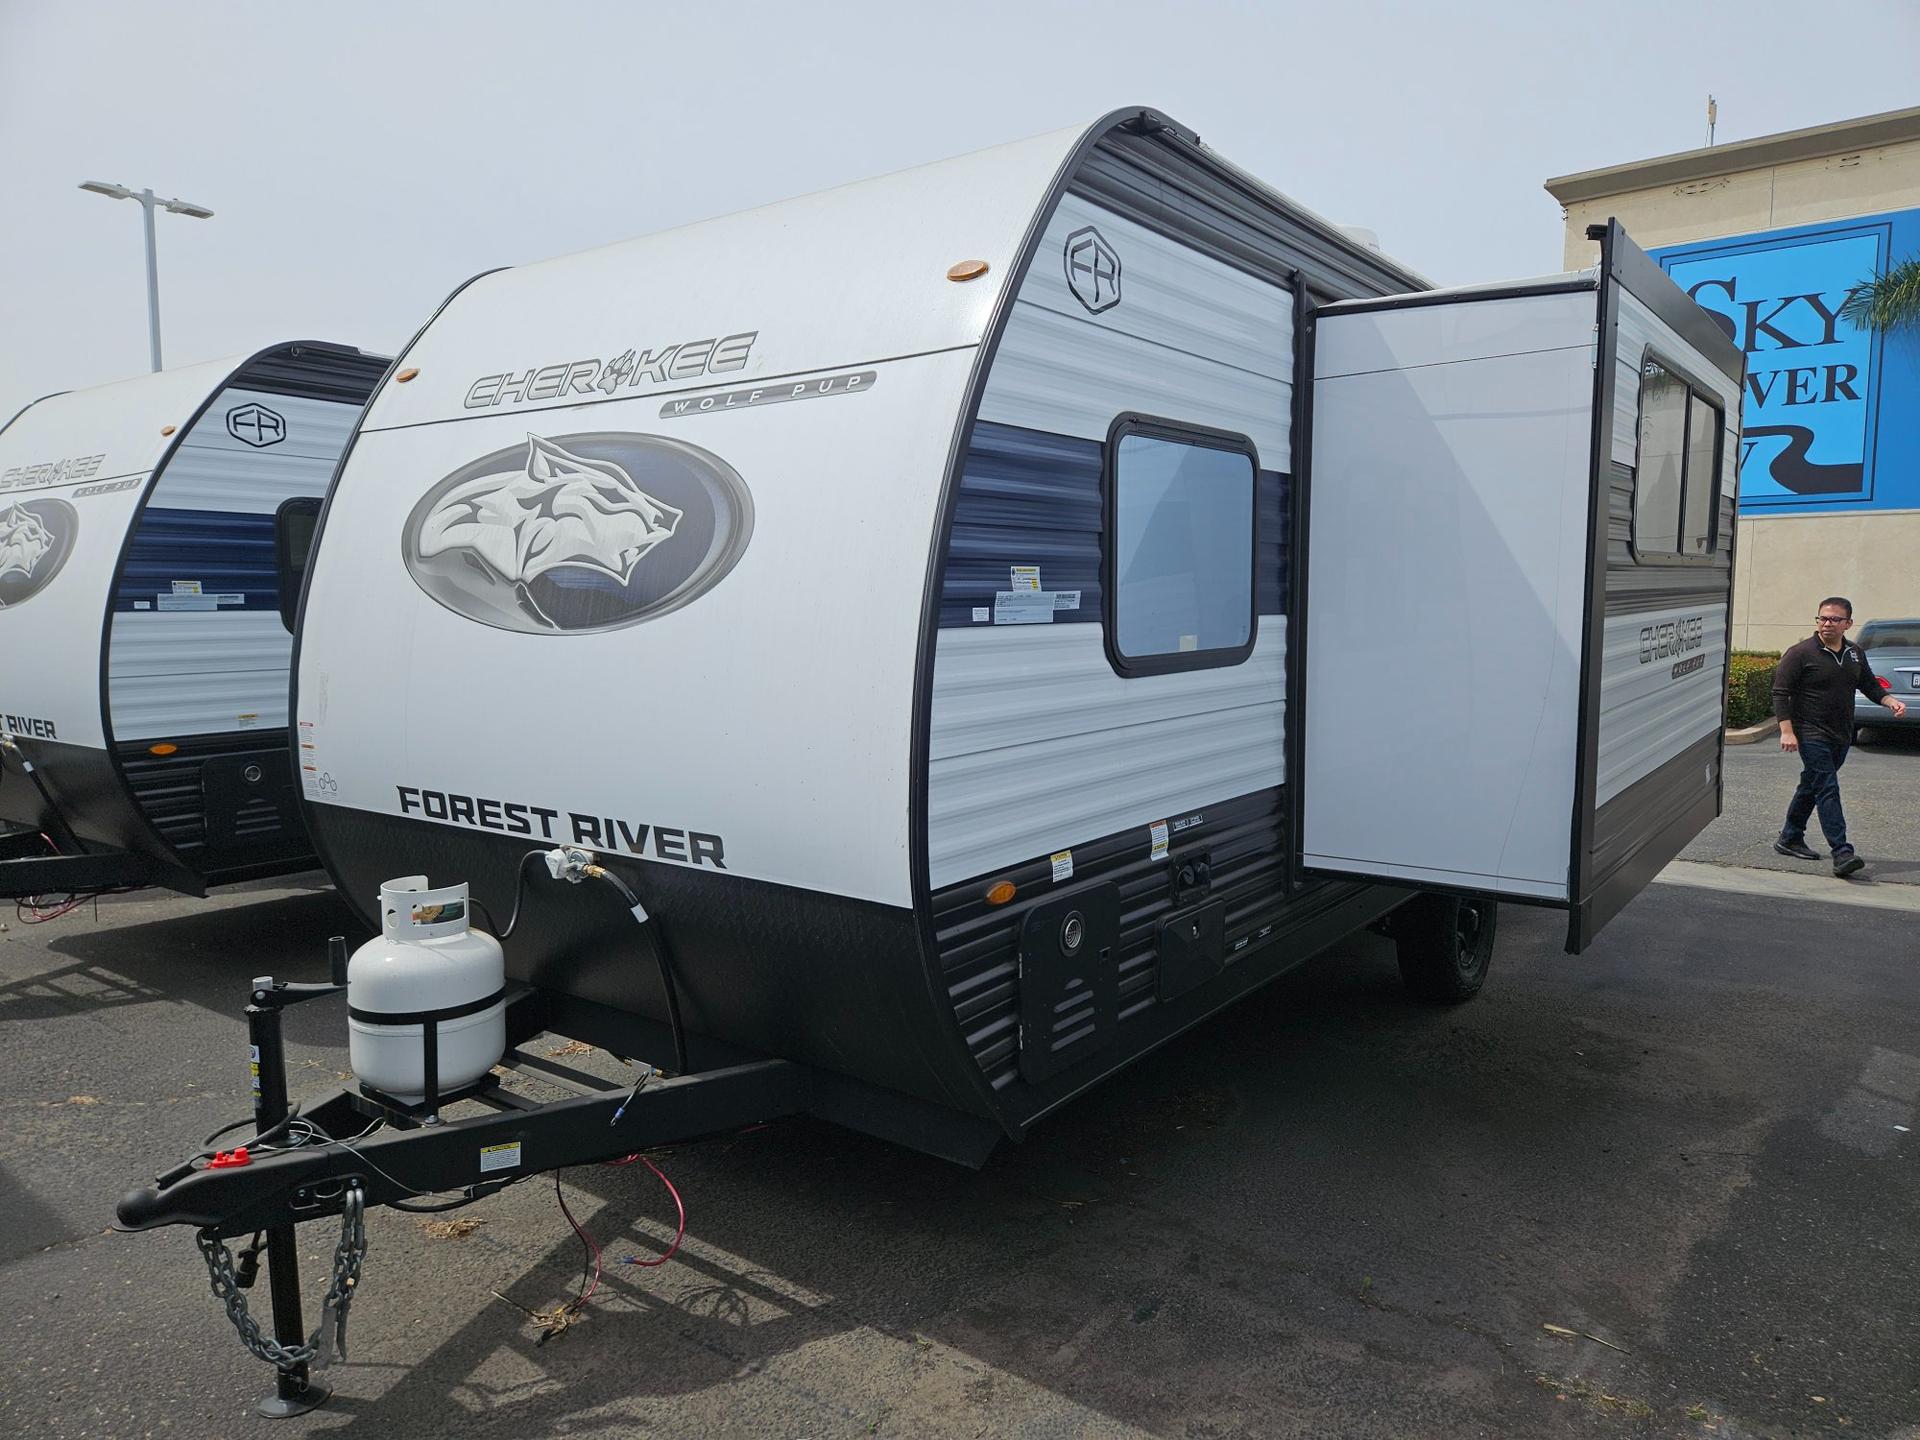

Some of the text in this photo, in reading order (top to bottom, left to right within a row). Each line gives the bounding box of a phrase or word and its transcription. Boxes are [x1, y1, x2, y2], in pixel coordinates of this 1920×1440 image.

[463, 330, 759, 410] CHEROKEE
[1746, 363, 1862, 409] VER
[673, 376, 862, 414] WOLF PUP
[6, 714, 58, 740] RIVER
[395, 785, 728, 870] FOREST RIVER
